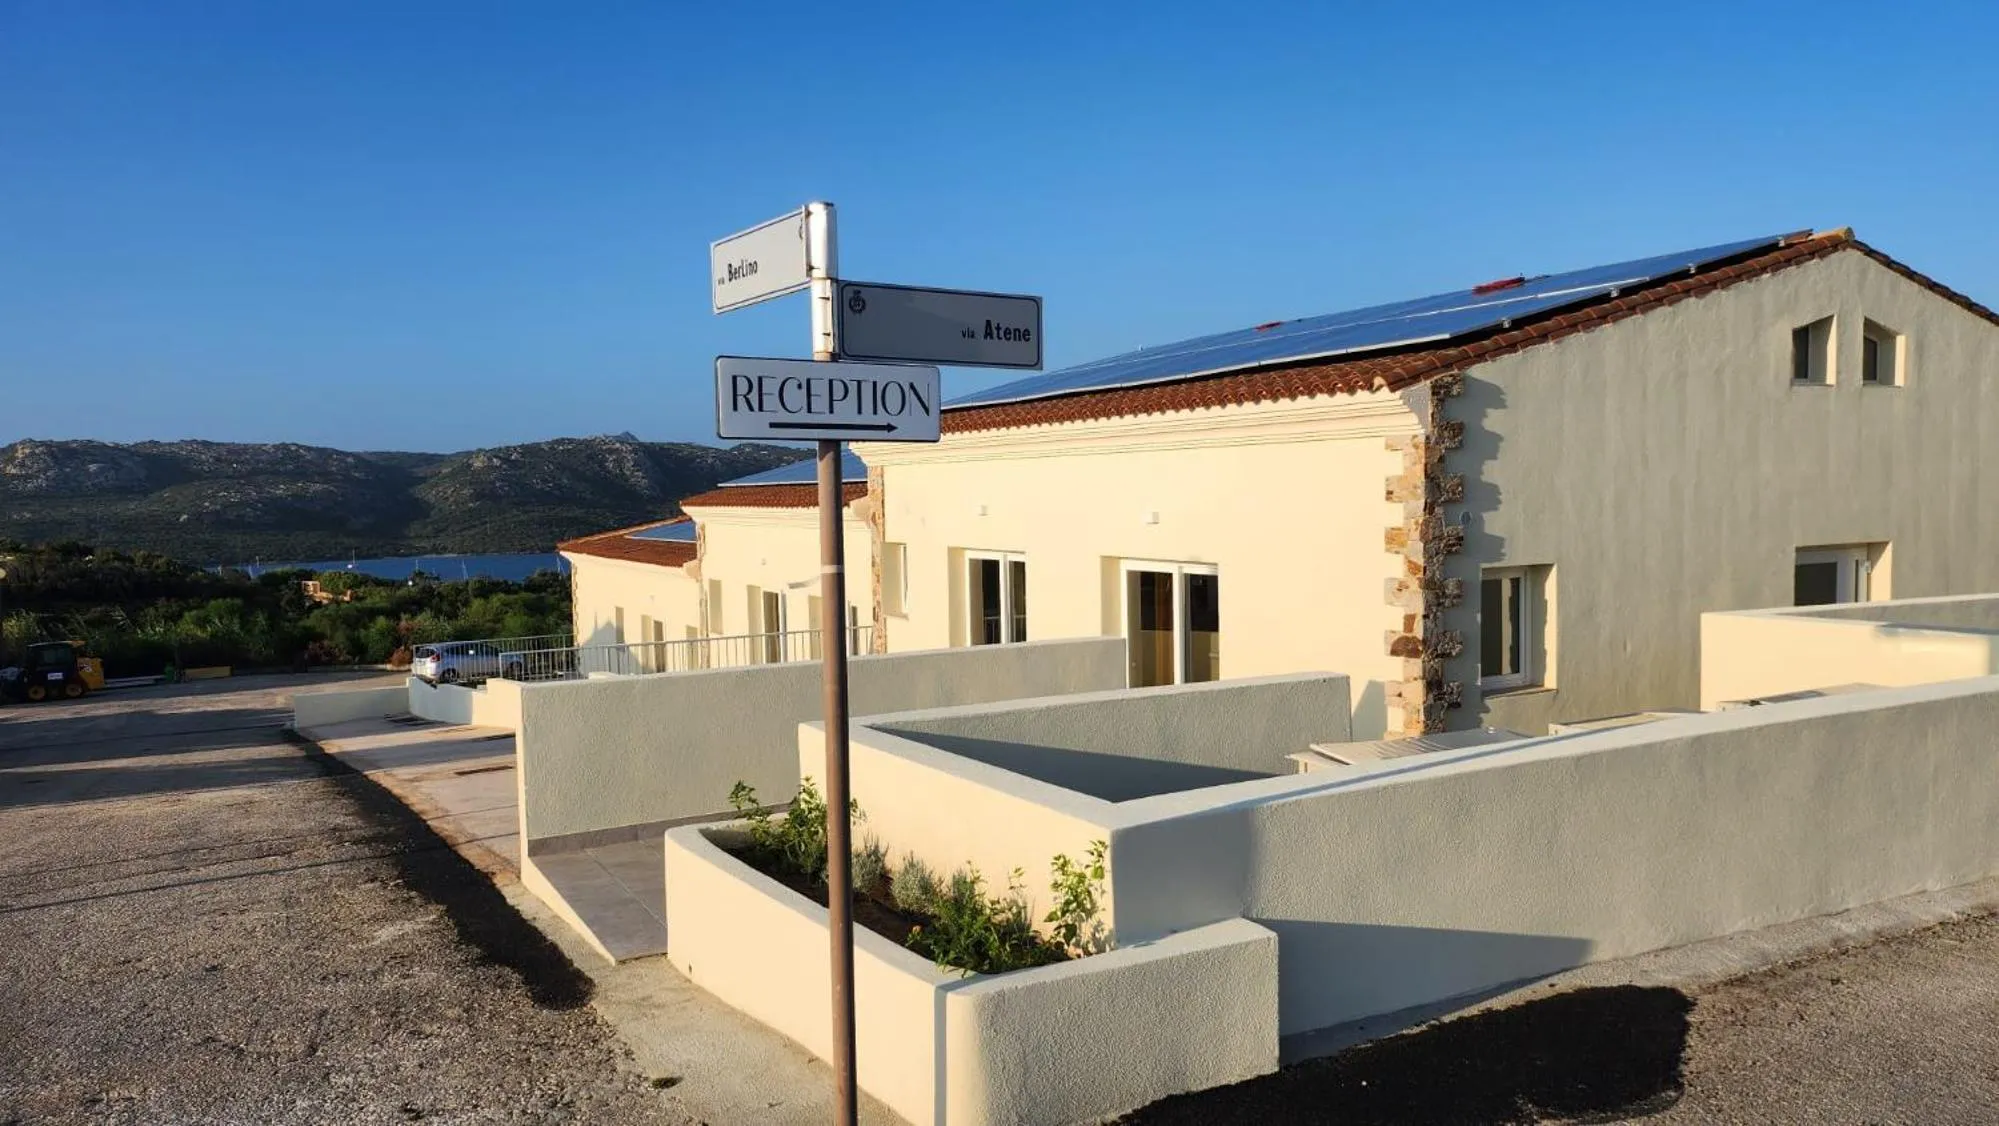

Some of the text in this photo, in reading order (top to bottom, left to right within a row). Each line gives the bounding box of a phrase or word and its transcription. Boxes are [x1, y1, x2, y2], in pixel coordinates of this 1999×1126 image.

[960, 319, 1031, 342] via Atene
[731, 374, 930, 417] RECEPTION
